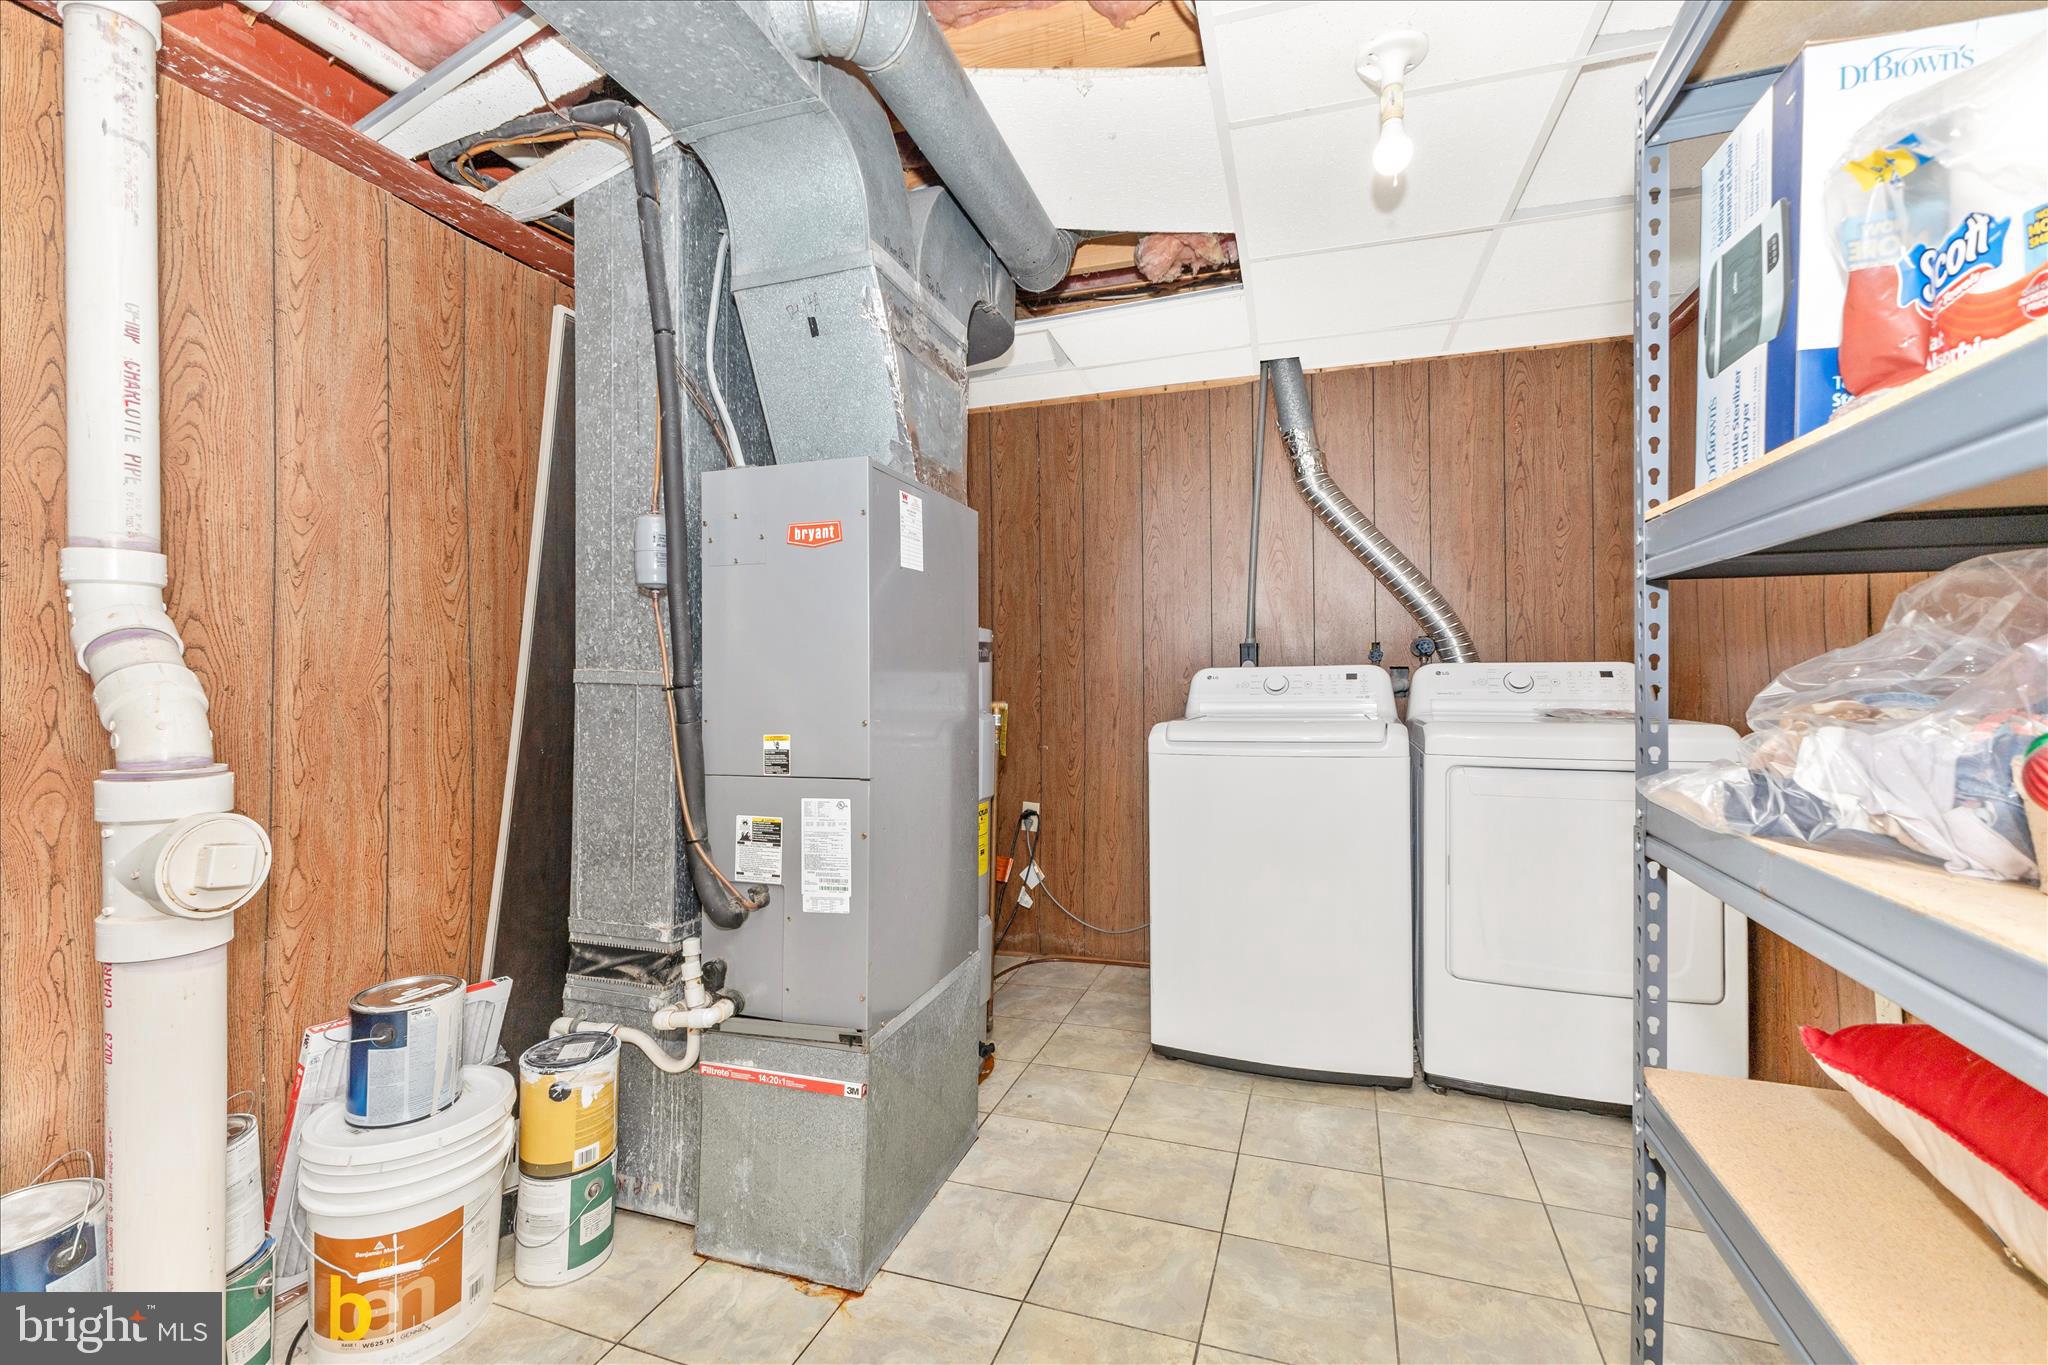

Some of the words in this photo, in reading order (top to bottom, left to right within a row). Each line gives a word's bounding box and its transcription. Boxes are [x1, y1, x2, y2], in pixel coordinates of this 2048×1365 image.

[1920, 213, 1990, 303] Scott
[1732, 368, 1741, 431] Sterilizer
[1741, 403, 1751, 441] Dryer
[794, 525, 835, 541] bryant
[701, 1065, 730, 1077] Filtrete
[846, 1086, 860, 1096] 3M
[355, 1249, 383, 1259] Benjamin
[330, 1275, 435, 1341] ben
[362, 1340, 384, 1349] W625
